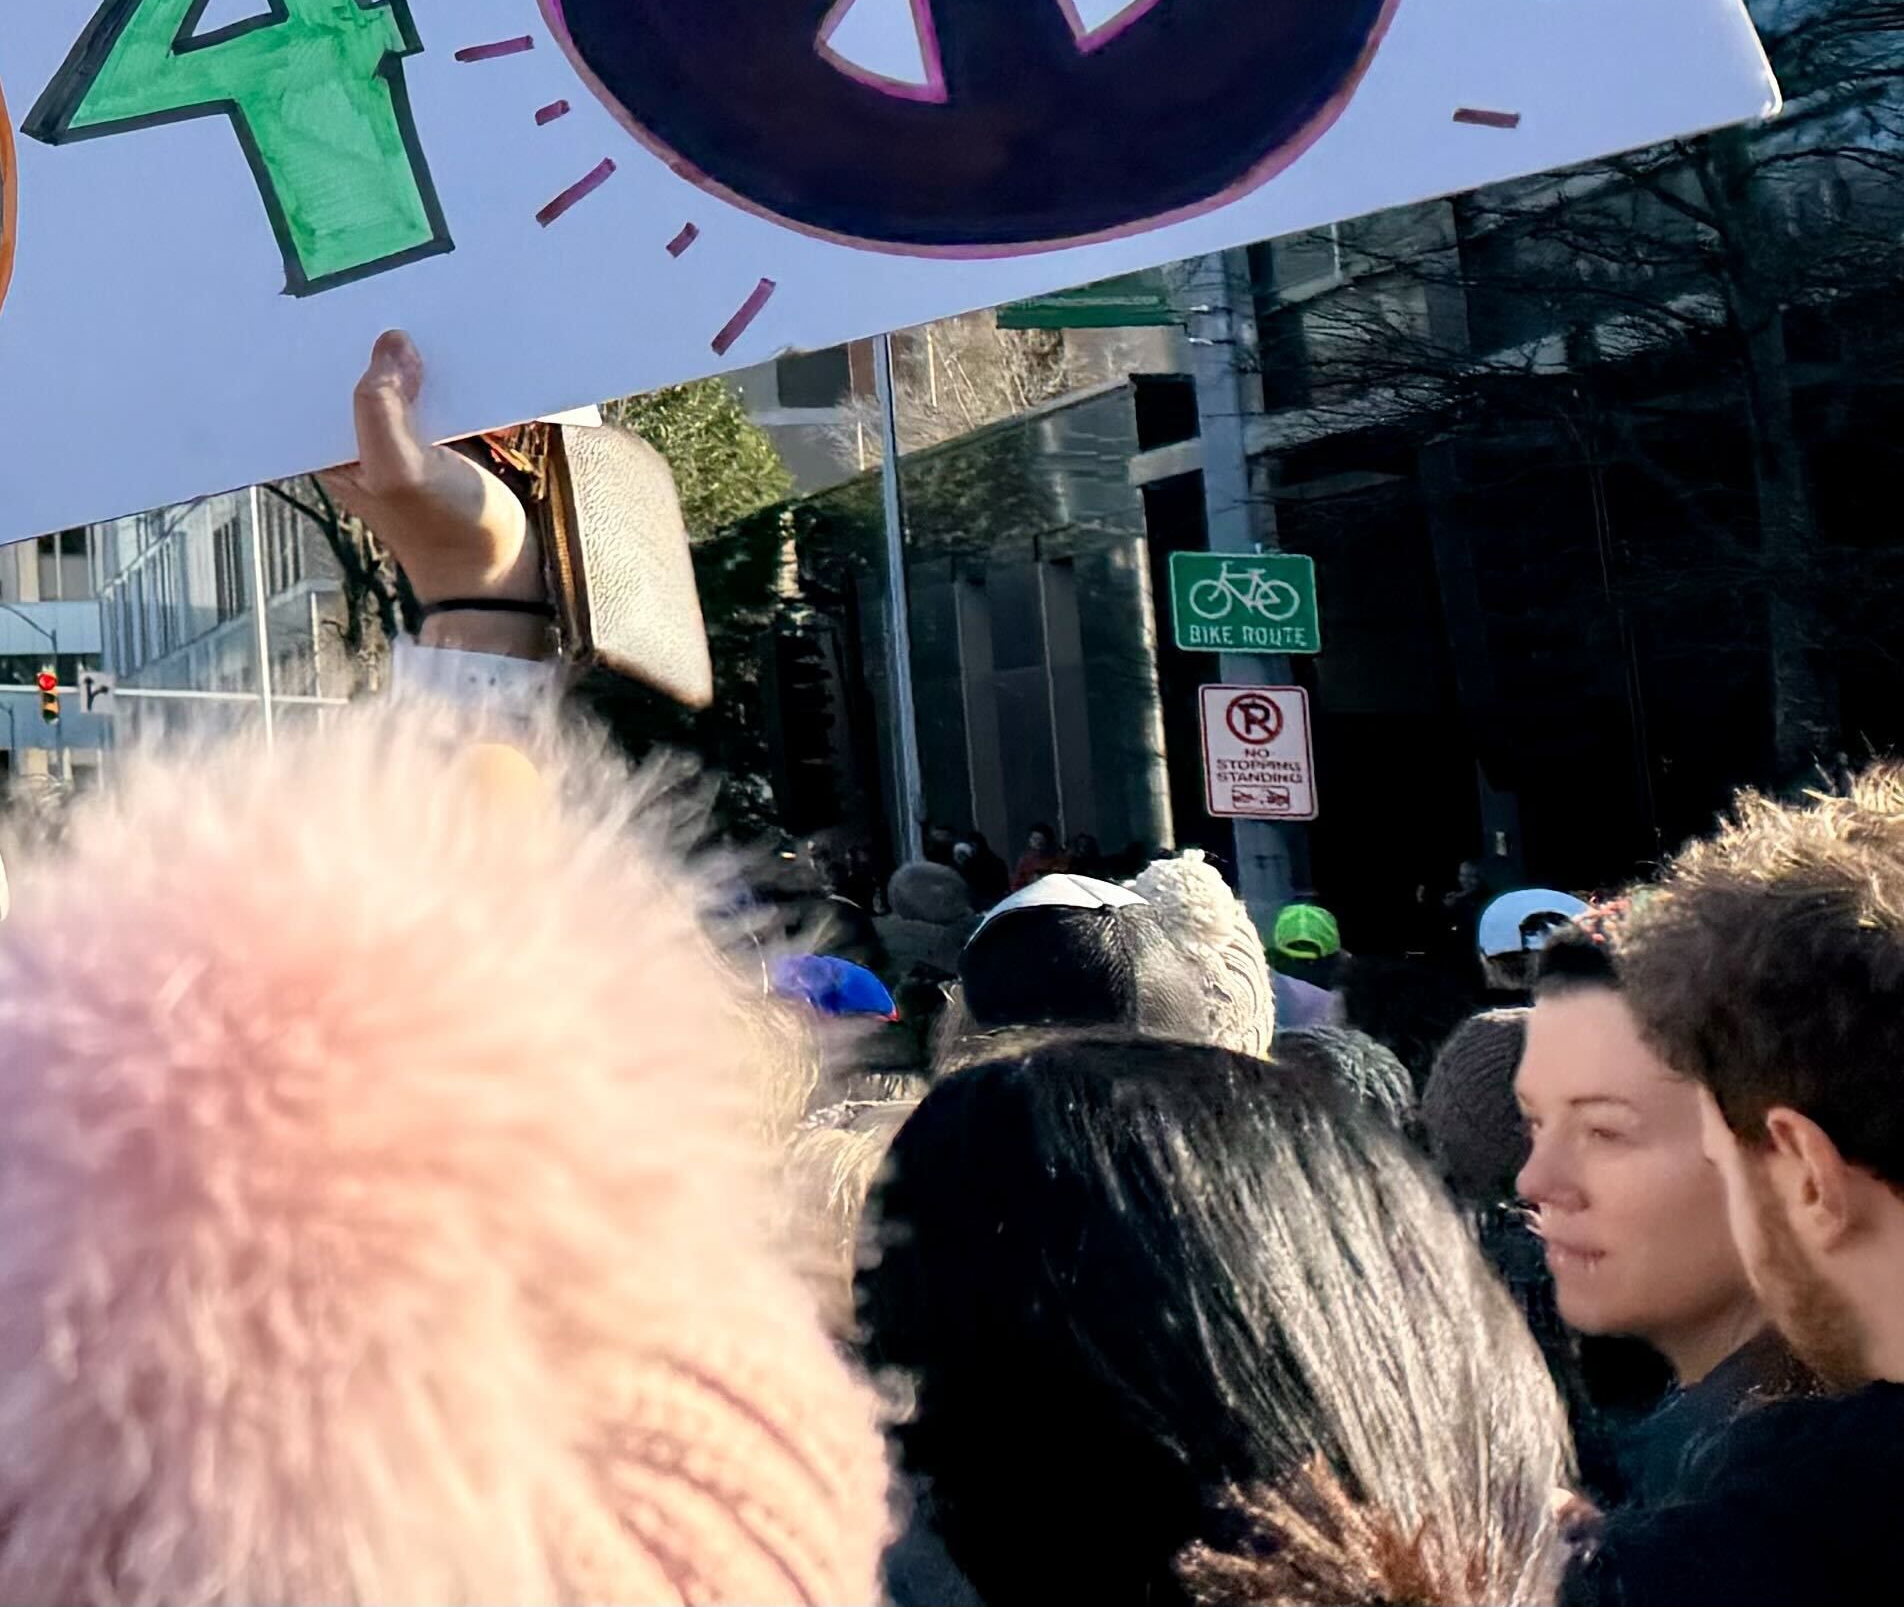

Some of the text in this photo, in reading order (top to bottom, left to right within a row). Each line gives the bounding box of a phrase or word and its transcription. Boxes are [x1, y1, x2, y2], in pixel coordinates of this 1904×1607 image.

[1190, 625, 1307, 646] BIKE ROUTE
[1245, 748, 1270, 758] NO
[1216, 759, 1301, 771] STOPPING
[1216, 772, 1303, 784] STANDING
